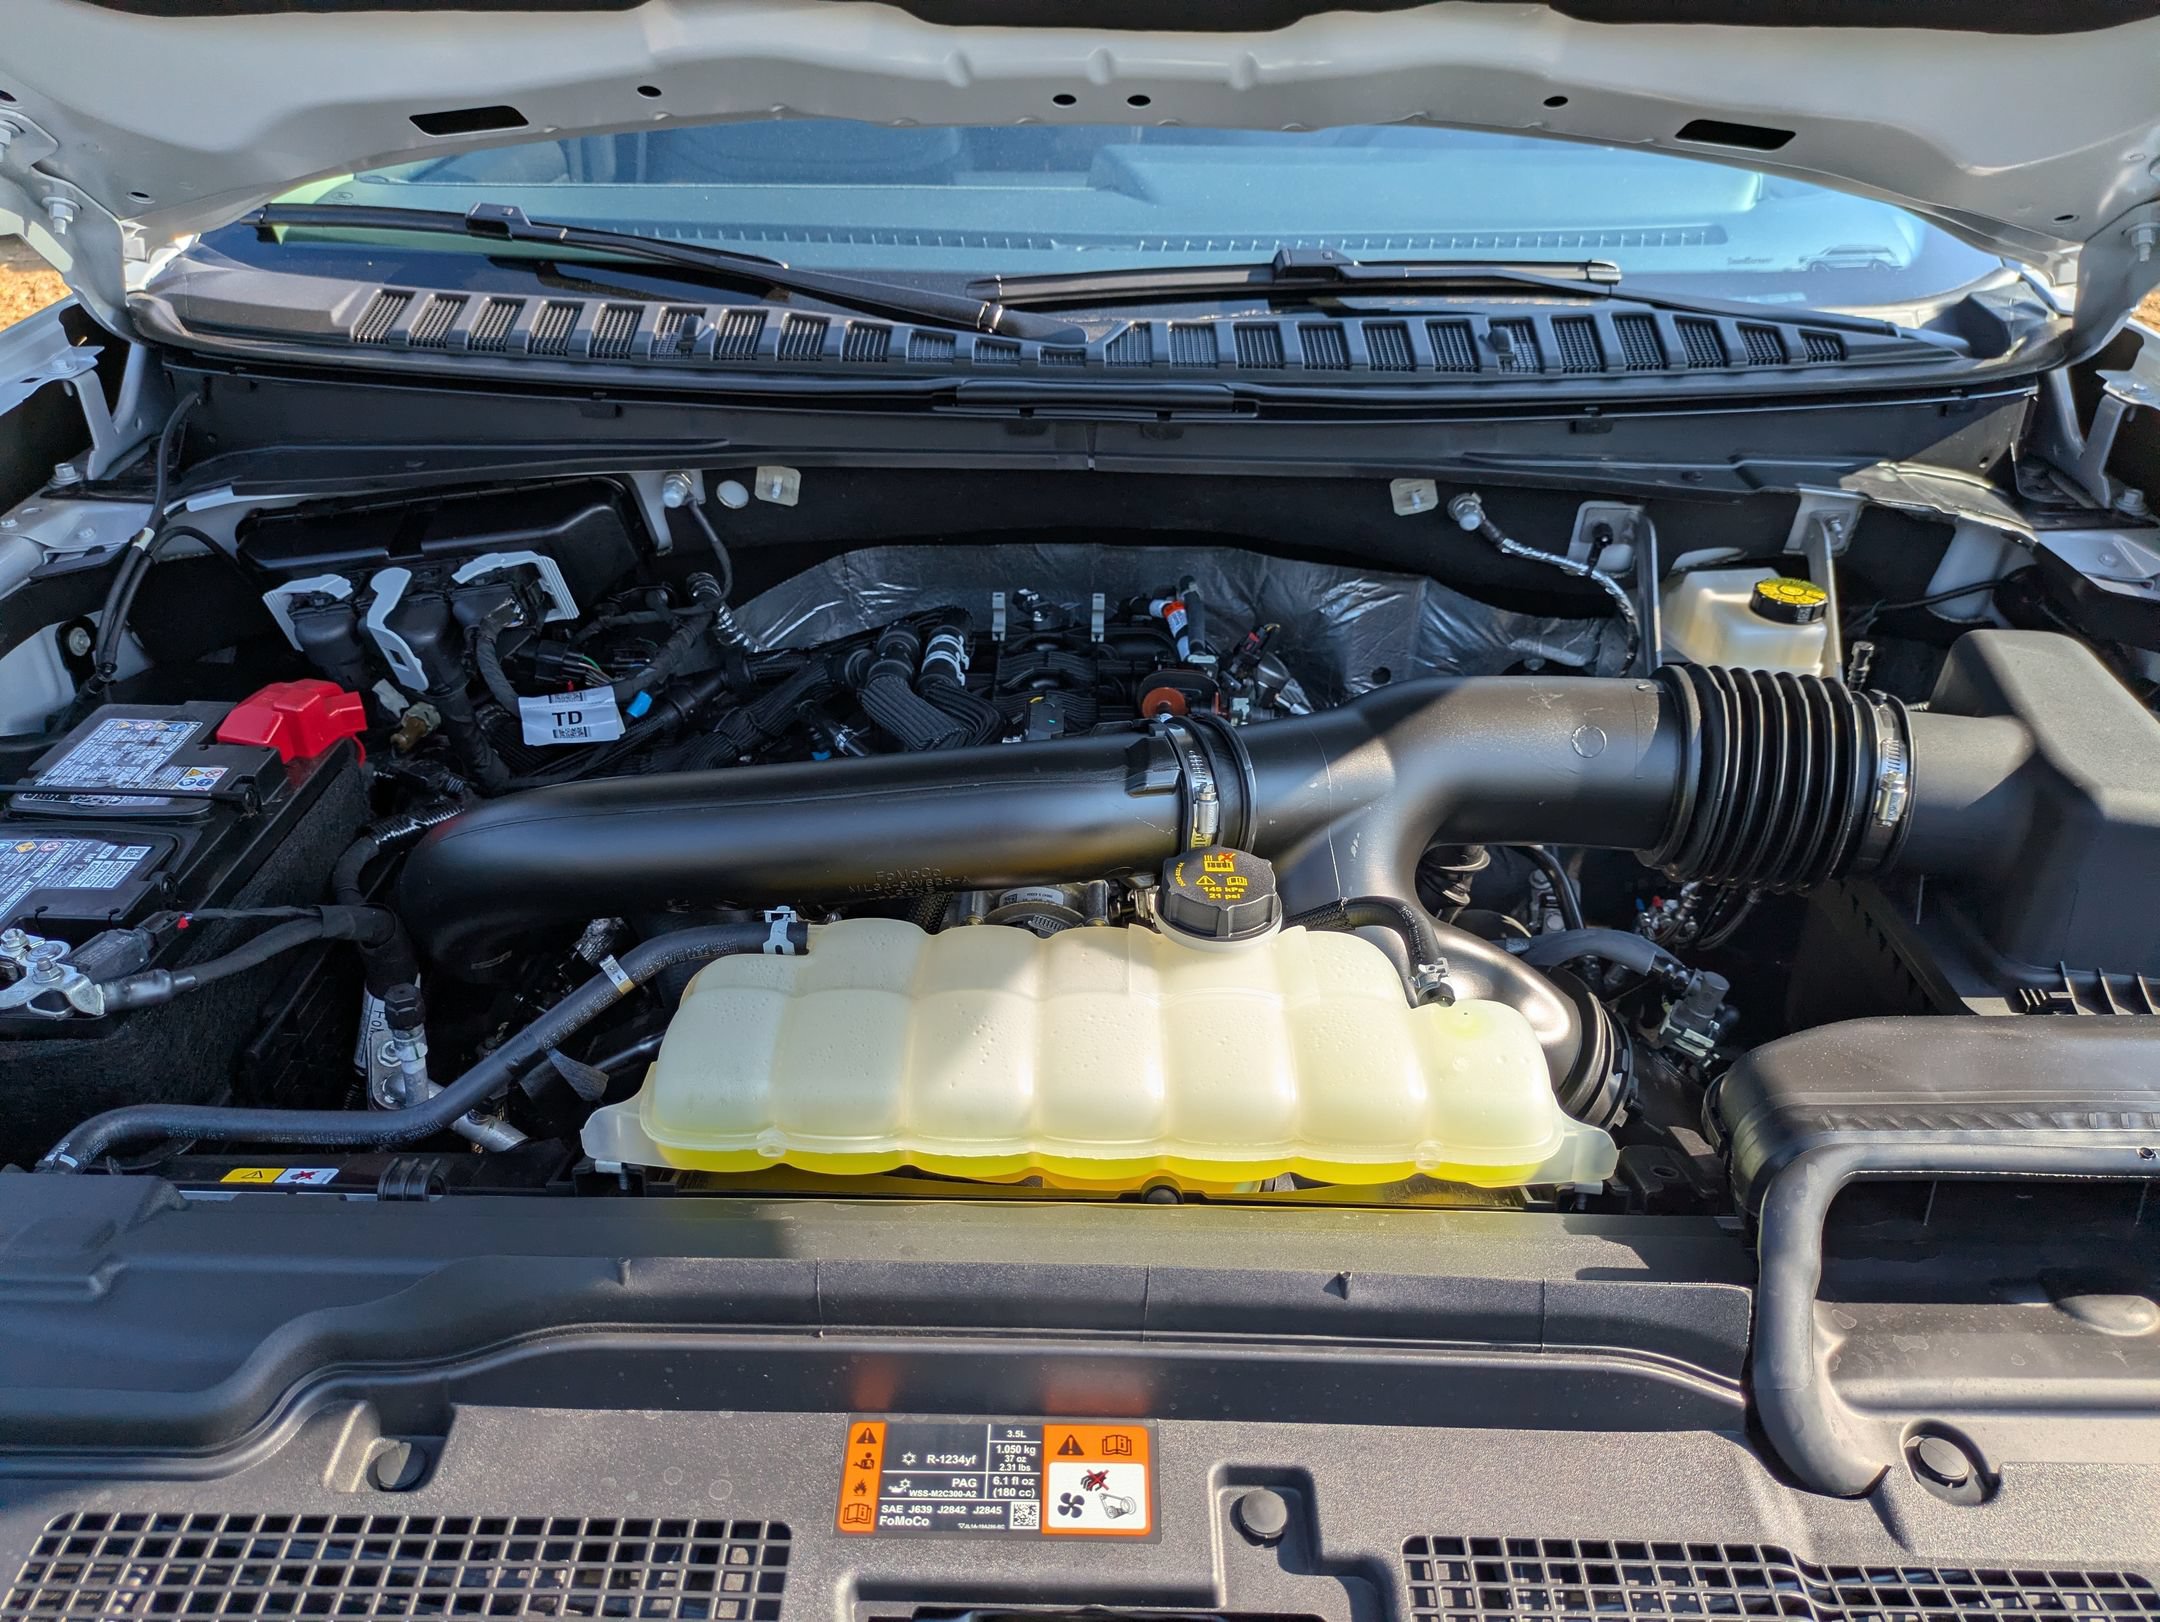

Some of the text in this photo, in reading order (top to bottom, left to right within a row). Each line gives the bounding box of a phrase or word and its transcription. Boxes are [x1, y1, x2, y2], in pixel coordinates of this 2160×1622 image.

[551, 710, 583, 727] TD
[875, 866, 942, 881] FoMoCo
[1006, 1430, 1027, 1438] 3.5L
[996, 1445, 1036, 1457] 1.050 kg
[926, 1454, 977, 1466] R-1234yf
[1004, 1455, 1015, 1463] 37
[999, 1463, 1031, 1472] 2.31 lbs
[952, 1478, 977, 1488] PAG
[993, 1476, 1035, 1486] 6.1 fl oz
[909, 1489, 977, 1498] WSS-M2C300-A2
[993, 1488, 1036, 1498] (180 cc)
[881, 1504, 1003, 1515] SAE J639 J2842 J2845
[879, 1516, 930, 1526] FoMoCo
